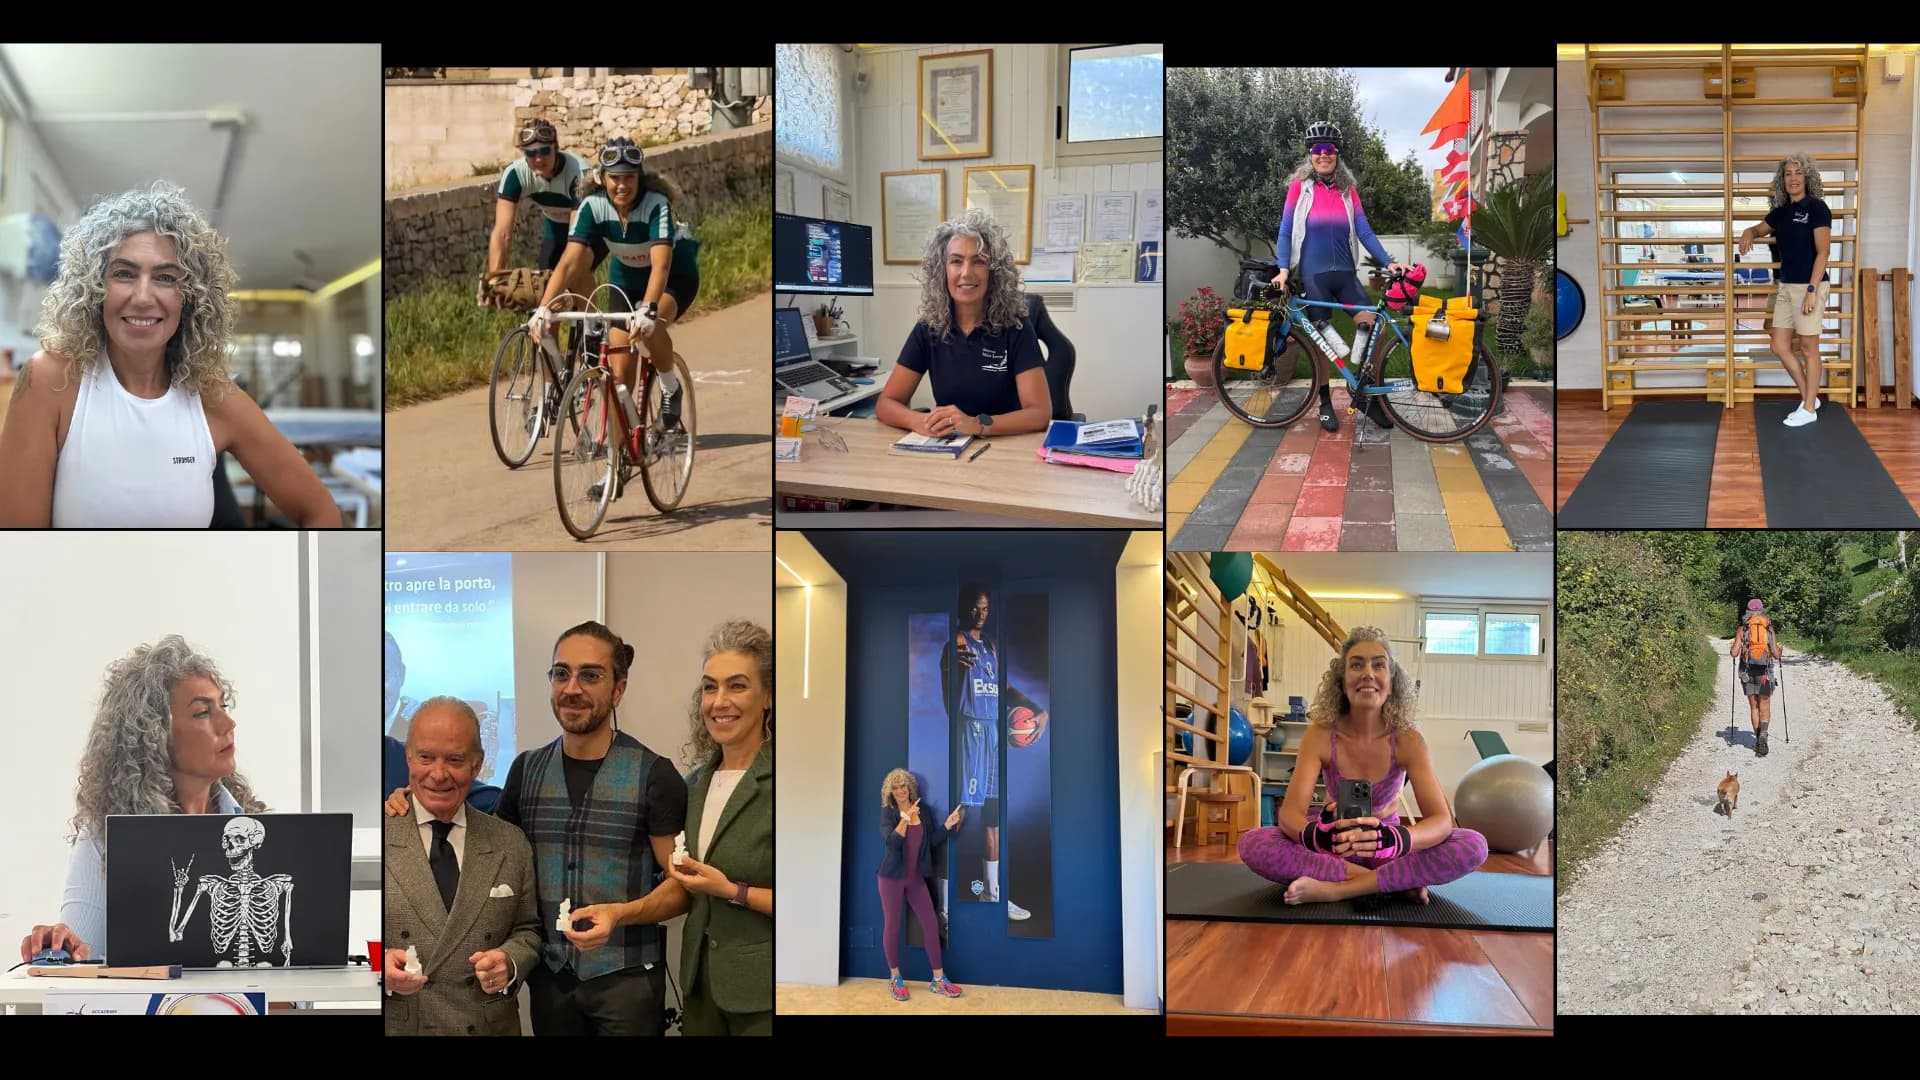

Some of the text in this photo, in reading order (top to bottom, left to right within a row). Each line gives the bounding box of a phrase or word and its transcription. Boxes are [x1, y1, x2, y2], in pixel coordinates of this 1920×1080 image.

[406, 579, 436, 593] apre
[439, 577, 451, 590] la
[455, 577, 496, 592] porta,
[394, 602, 441, 614] entrare
[445, 600, 459, 613] da
[968, 777, 978, 795] 8
